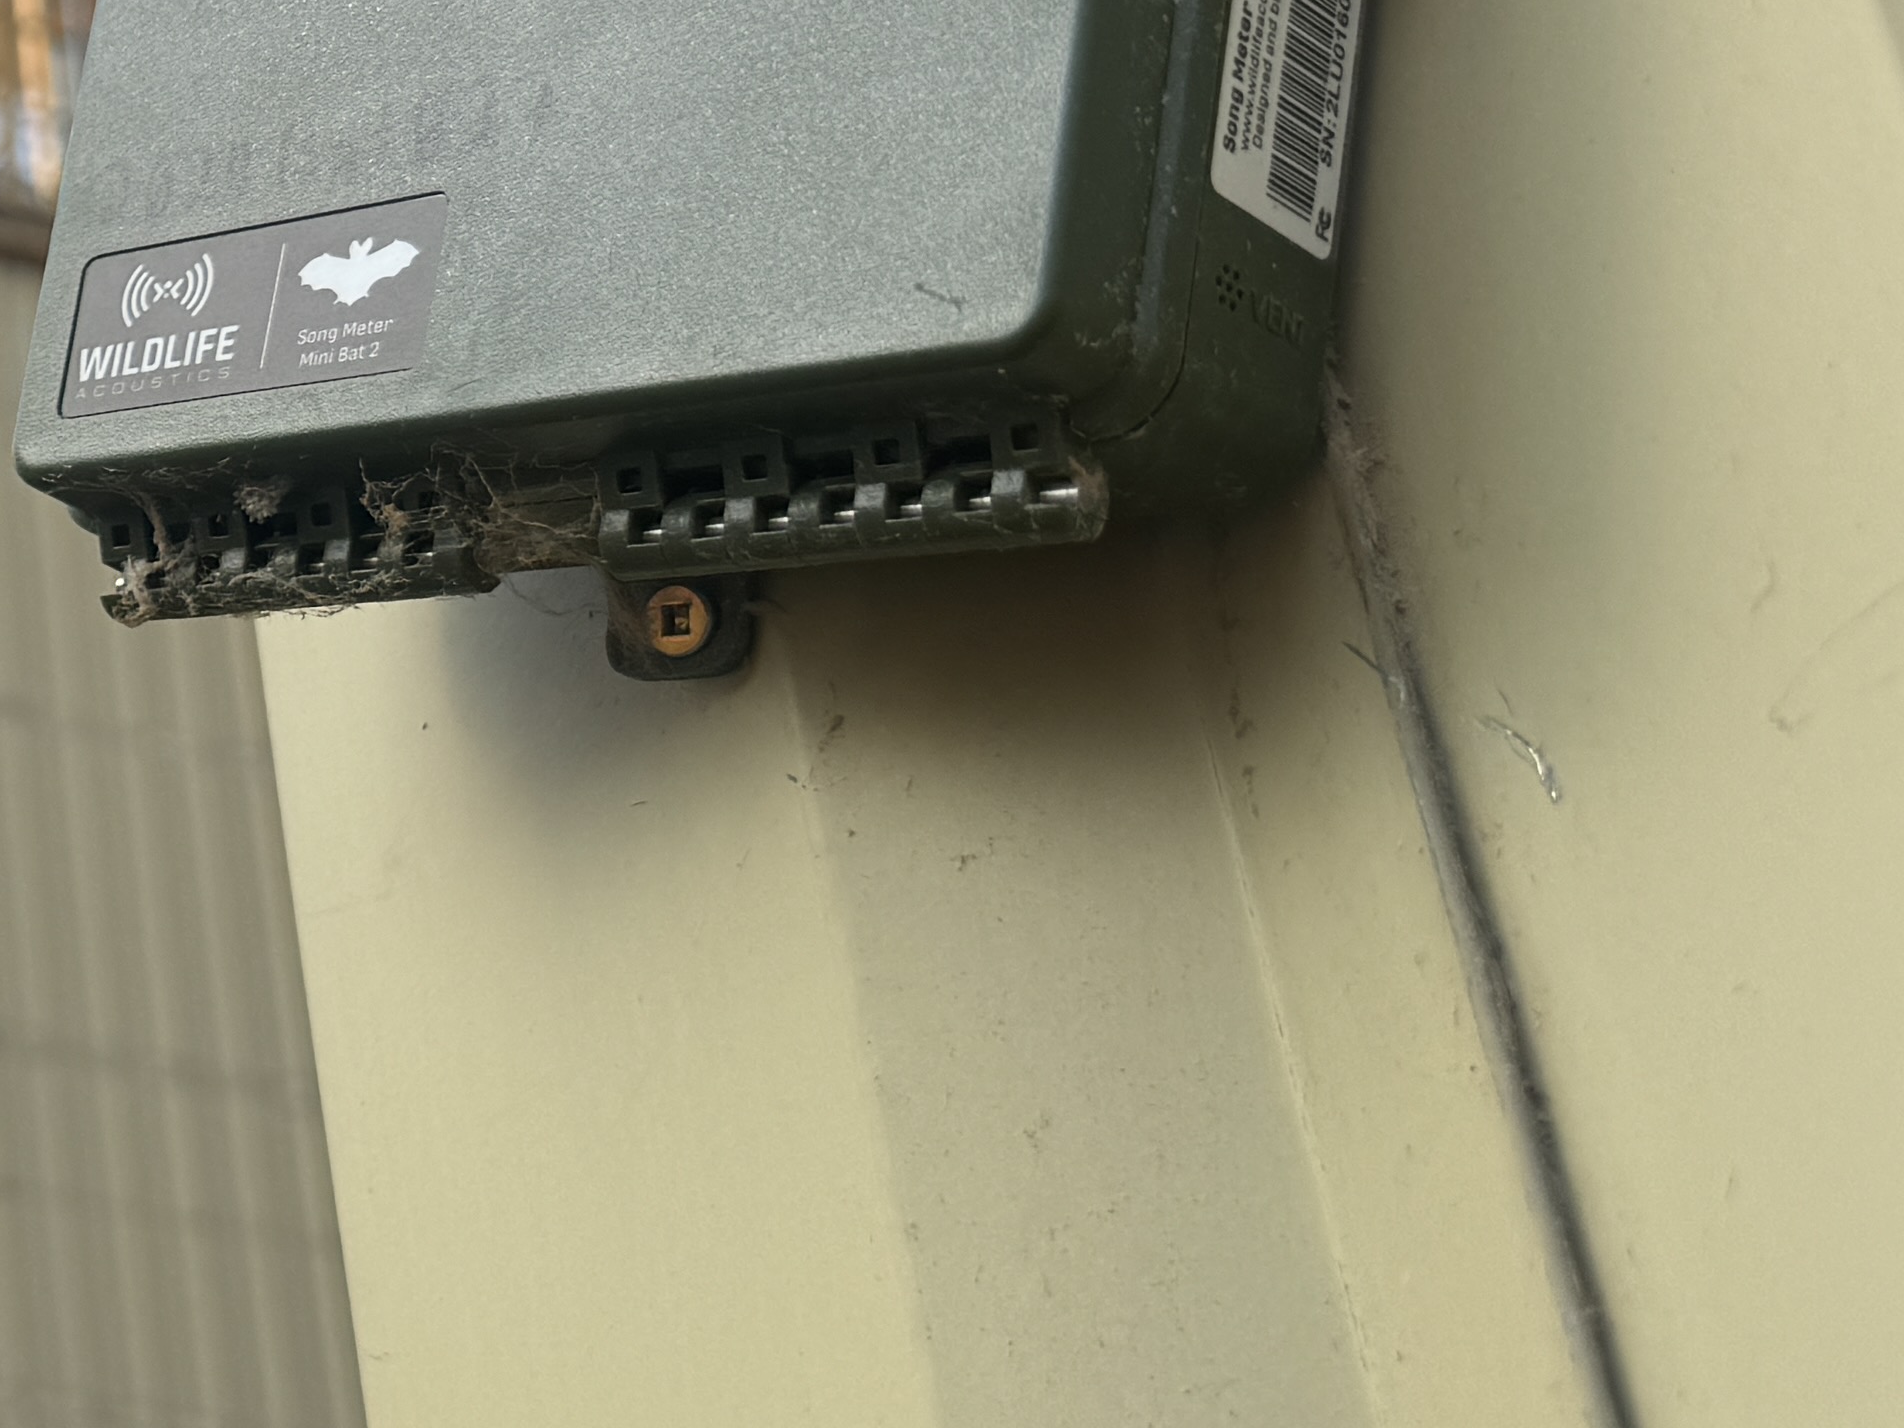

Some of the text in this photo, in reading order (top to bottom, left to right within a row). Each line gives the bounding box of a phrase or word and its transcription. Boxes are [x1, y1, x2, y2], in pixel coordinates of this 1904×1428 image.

[1232, 0, 1252, 83] Meter
[1252, 58, 1272, 150] Designed
[1266, 17, 1277, 56] and
[1222, 85, 1244, 153] Song
[79, 325, 240, 382] WILDLIFE
[297, 319, 394, 345] Song Meter
[298, 341, 380, 368] Mini Bat 2
[75, 366, 231, 399] ACOUSTICS
